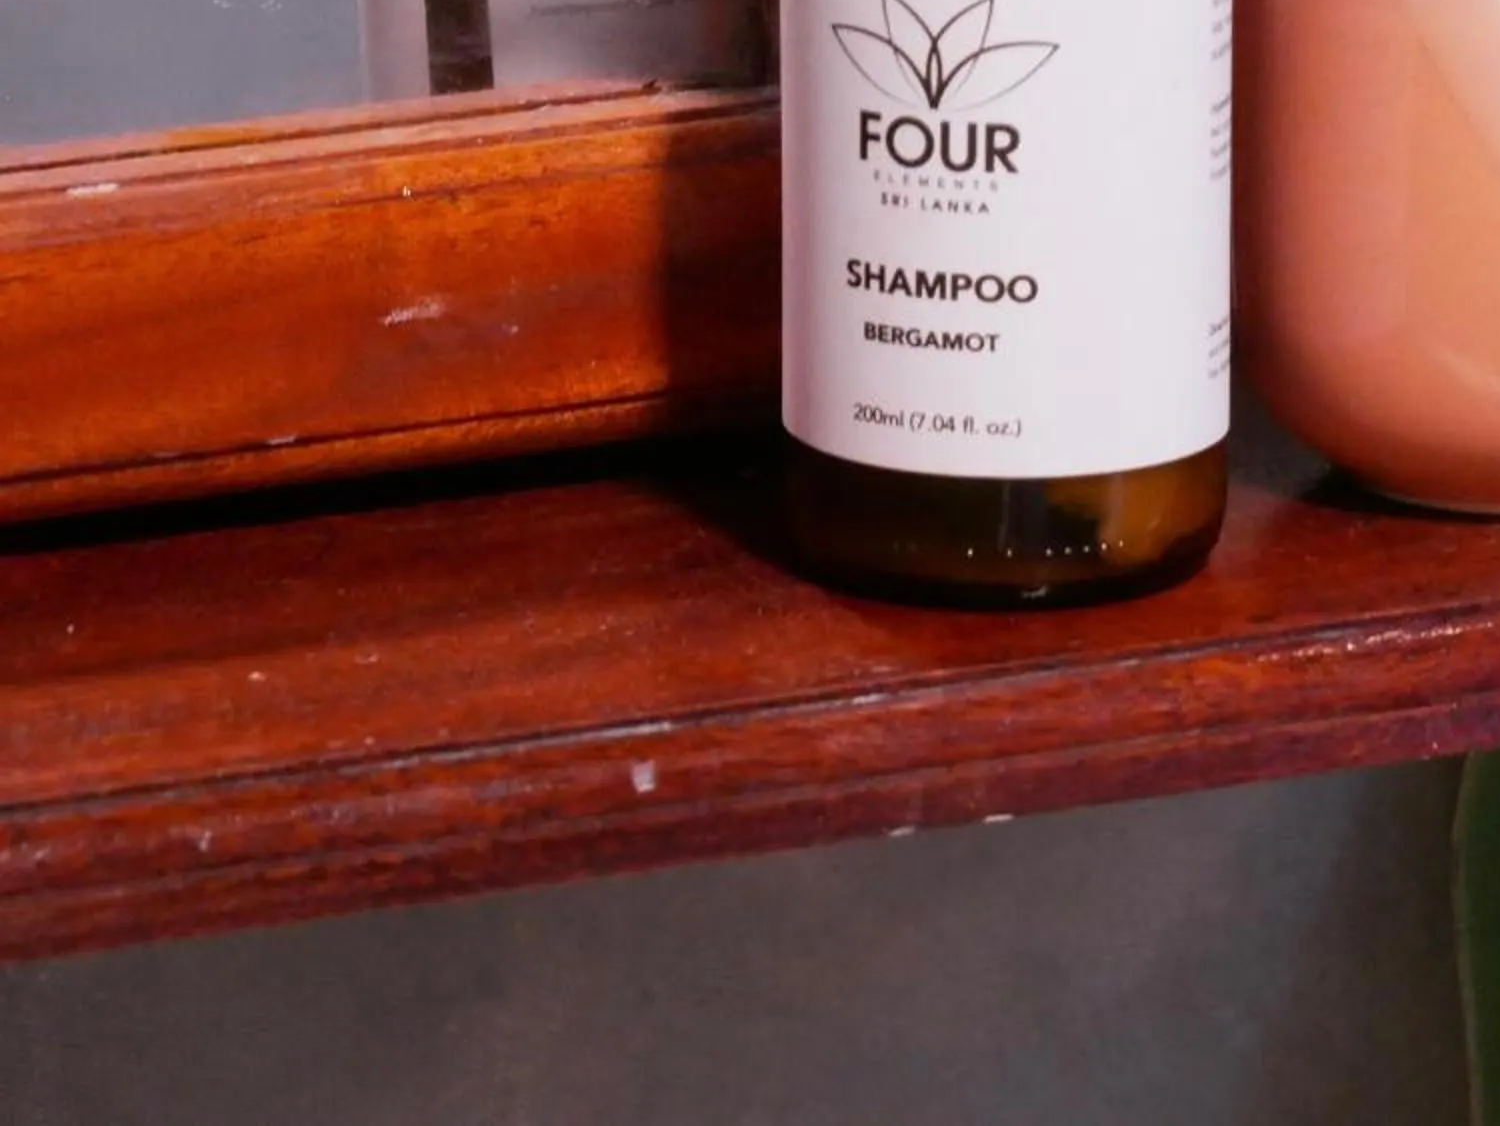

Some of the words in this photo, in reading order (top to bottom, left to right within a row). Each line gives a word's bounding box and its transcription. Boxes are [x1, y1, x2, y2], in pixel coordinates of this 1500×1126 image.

[858, 109, 1021, 174] FOUR
[872, 170, 1001, 193] ELEMENTS
[879, 191, 910, 209] SRI
[920, 195, 990, 214] LANKA
[846, 258, 1039, 303] SHAMPOO
[863, 321, 1000, 352] BERGAMOT
[852, 403, 905, 429] 200ml
[909, 411, 957, 436] (7.04
[961, 414, 980, 436] fl.
[985, 417, 1023, 439] oz.)
